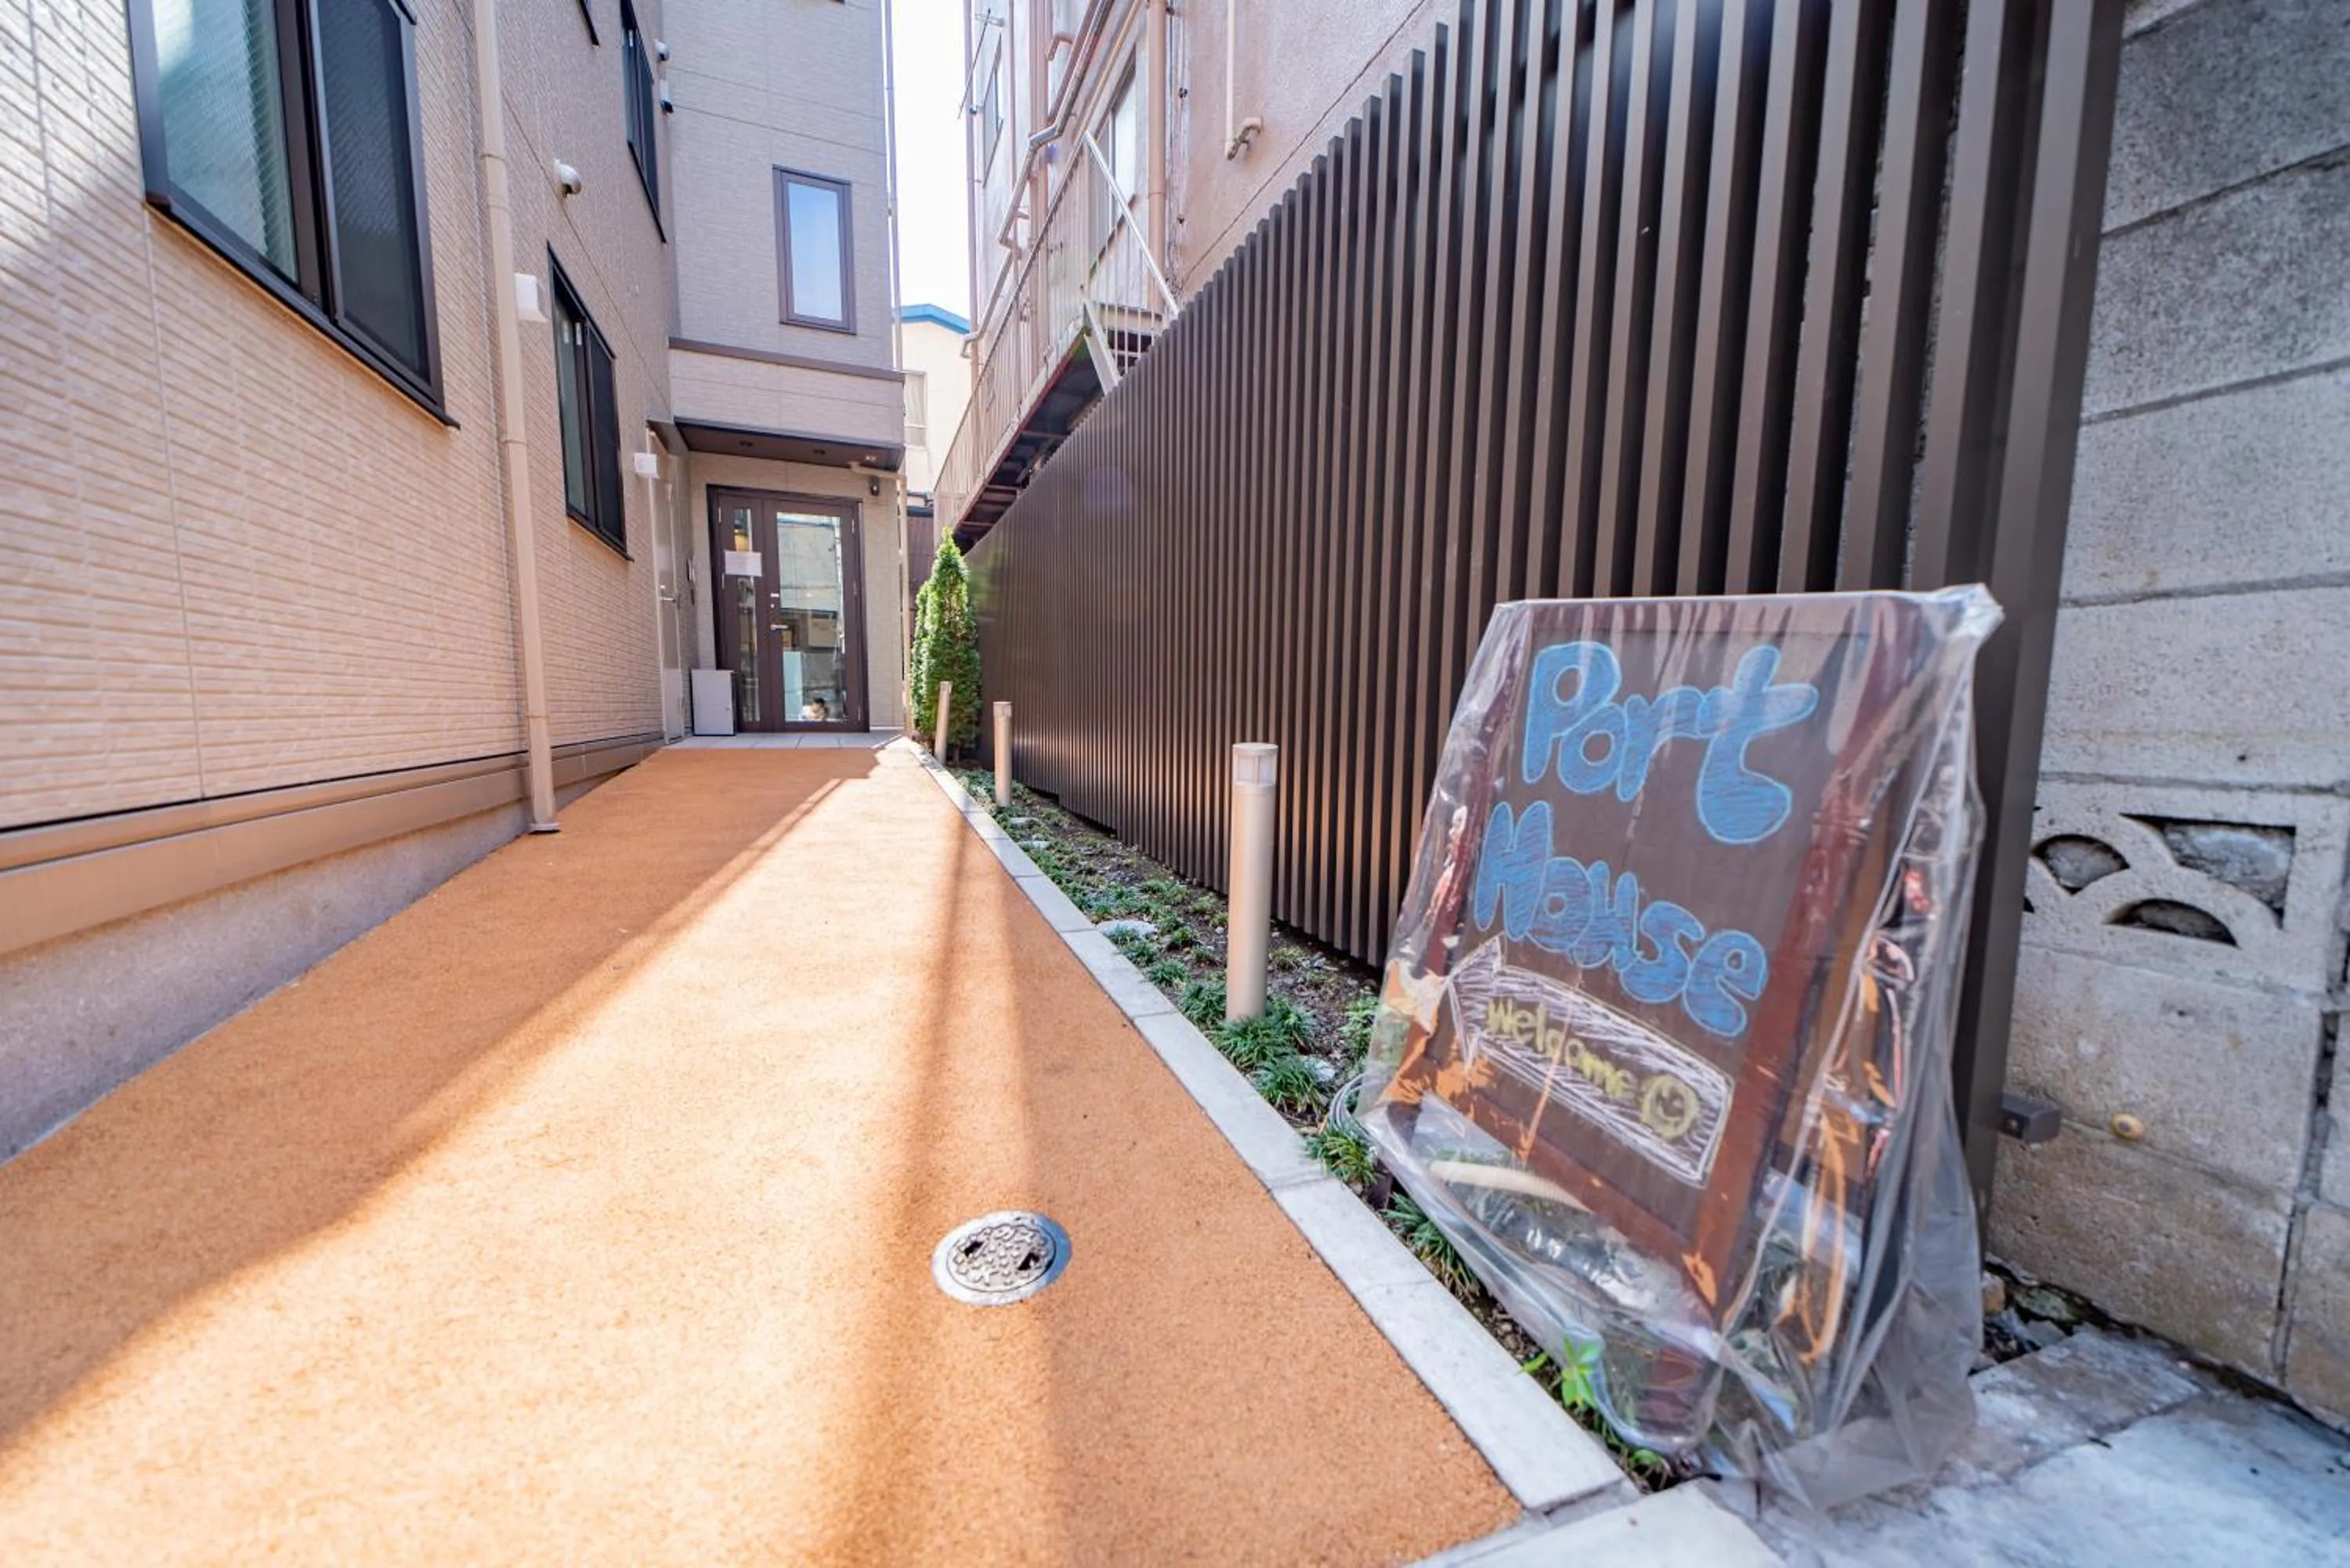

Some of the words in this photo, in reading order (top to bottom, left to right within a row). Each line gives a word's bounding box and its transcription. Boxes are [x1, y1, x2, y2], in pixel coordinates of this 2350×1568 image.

[1523, 641, 1818, 844] Port
[1474, 800, 1767, 1035] House
[1487, 995, 1639, 1100] Welcome
